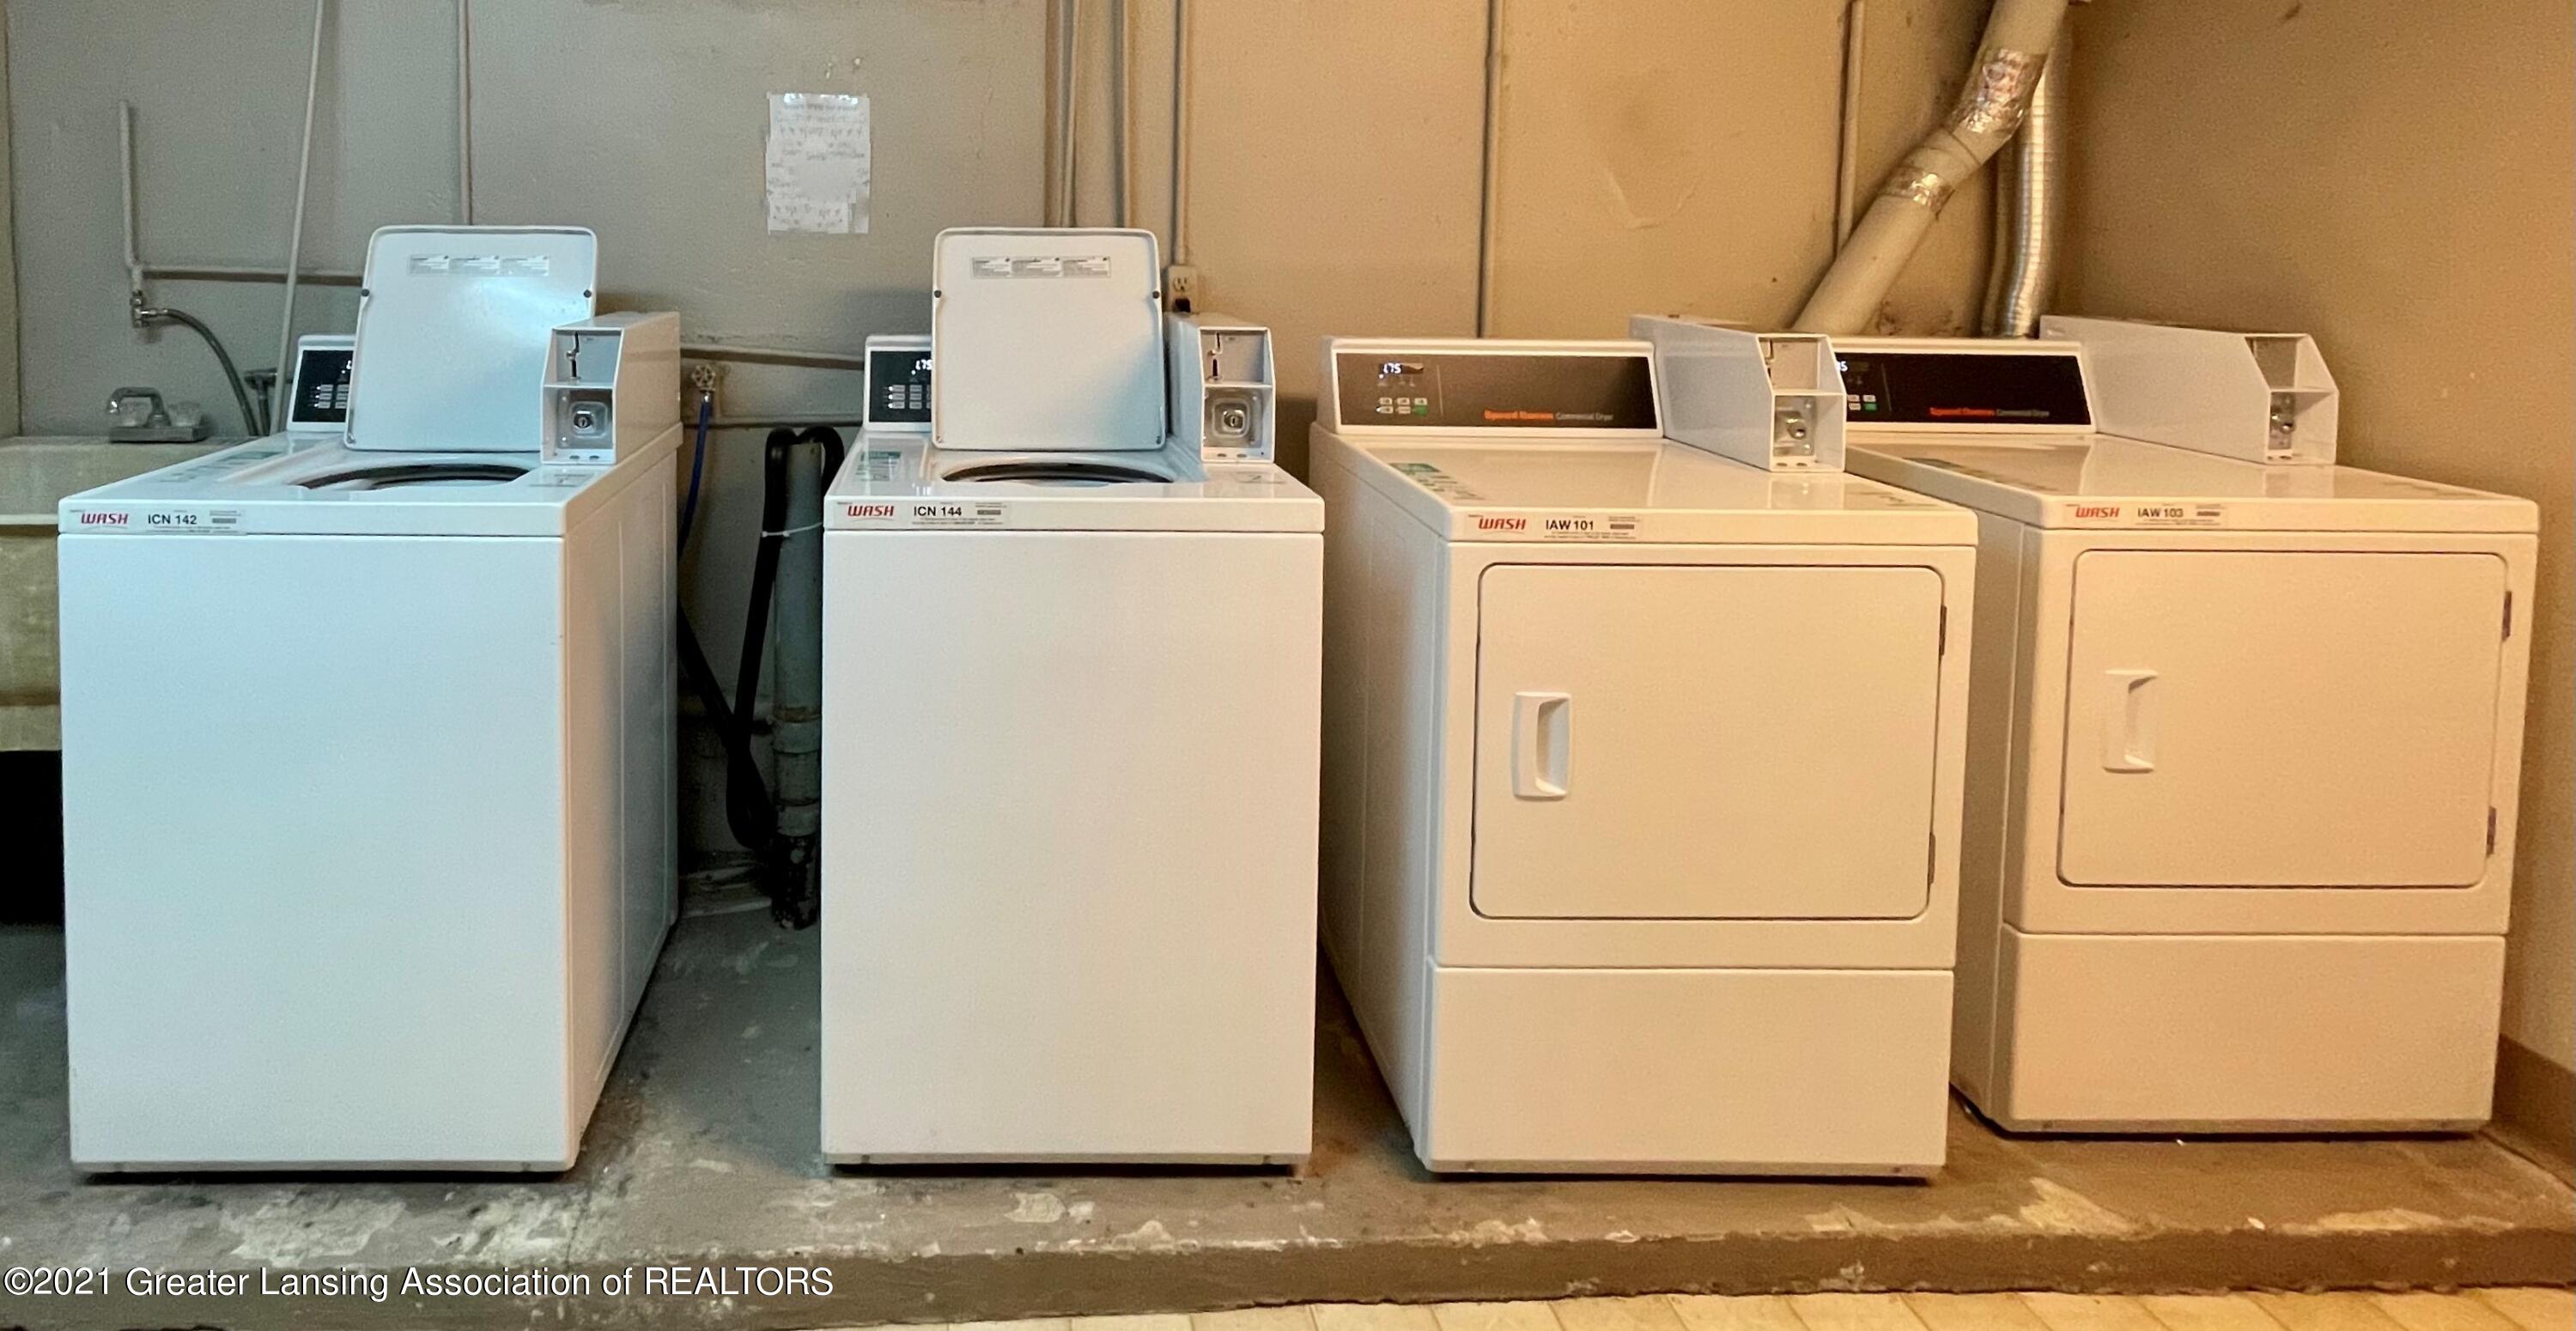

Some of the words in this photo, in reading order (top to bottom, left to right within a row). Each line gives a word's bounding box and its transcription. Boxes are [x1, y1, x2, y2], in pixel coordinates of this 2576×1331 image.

[847, 505, 895, 517] WASH
[914, 506, 936, 517] ICN
[941, 506, 963, 517] 144
[2075, 507, 2120, 518] WASH
[2137, 507, 2160, 518] IAW
[2163, 507, 2184, 518] 103
[81, 513, 129, 525] WASH
[148, 514, 171, 525] ICN
[175, 514, 197, 526] 142
[1478, 518, 1527, 530] WASH
[1546, 520, 1571, 530] IAW
[1574, 520, 1595, 531] 101
